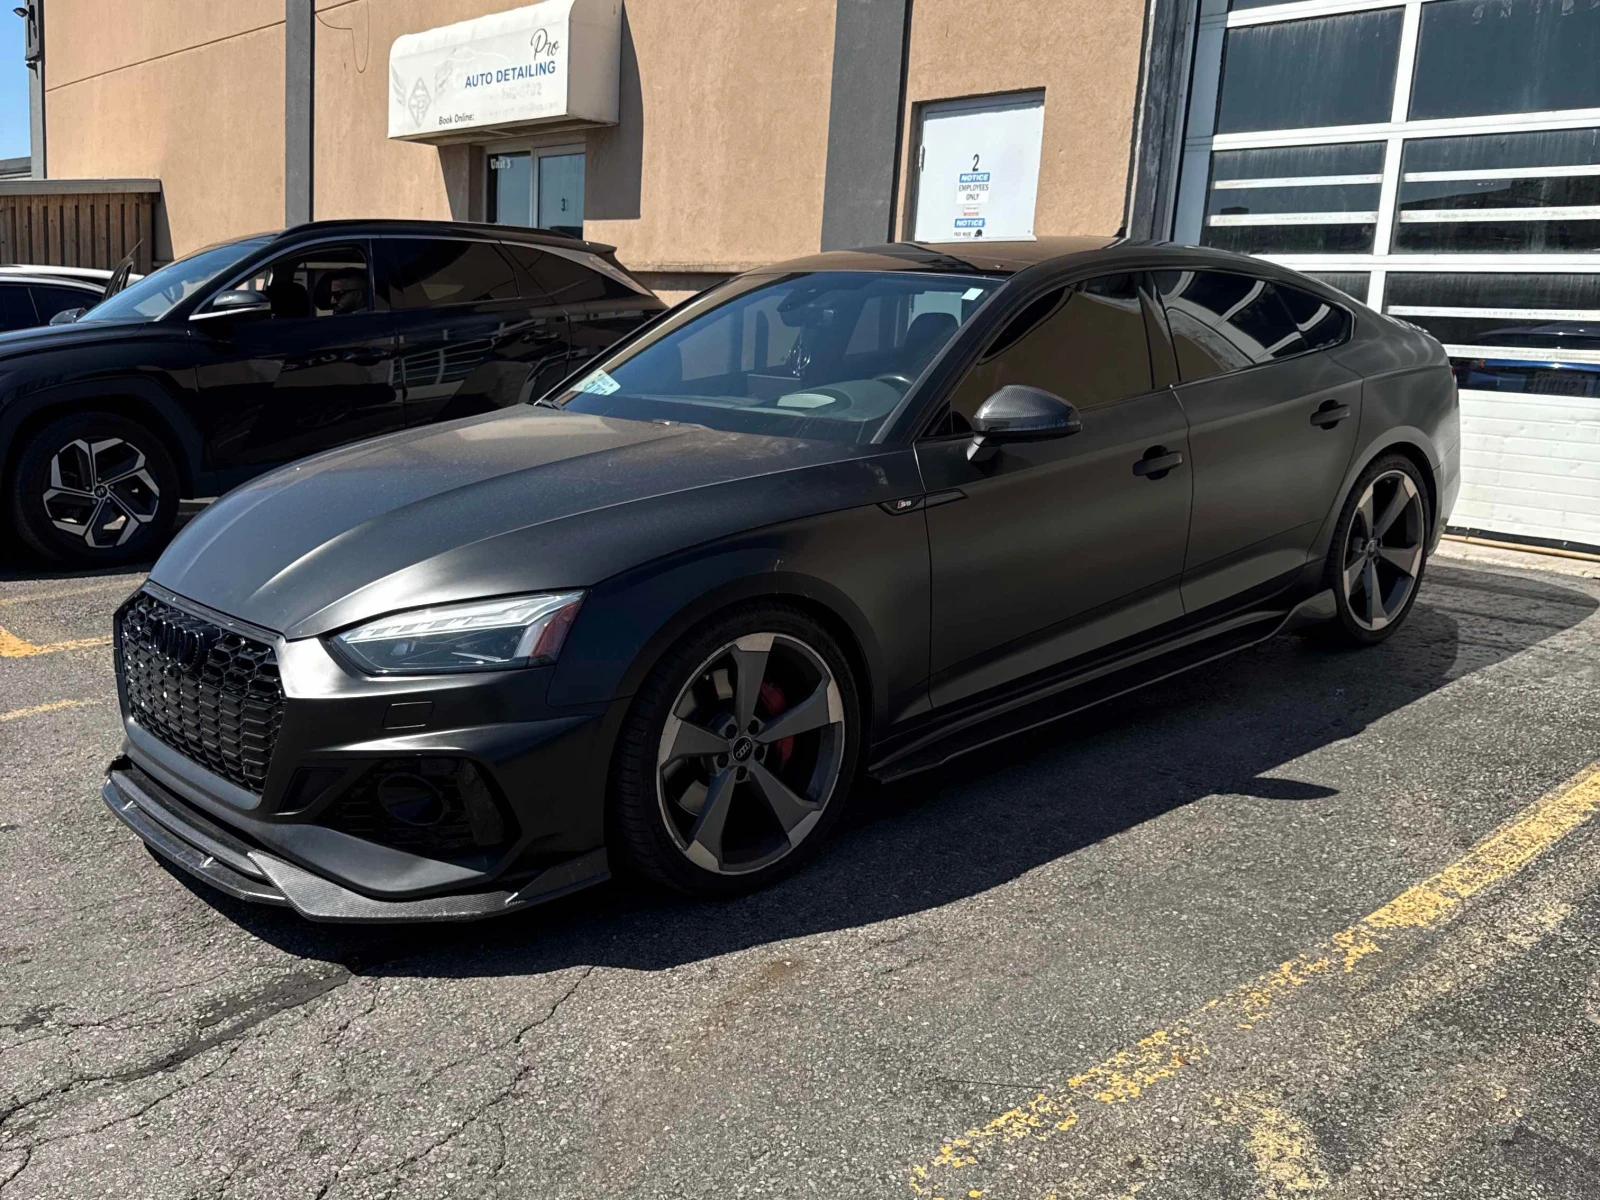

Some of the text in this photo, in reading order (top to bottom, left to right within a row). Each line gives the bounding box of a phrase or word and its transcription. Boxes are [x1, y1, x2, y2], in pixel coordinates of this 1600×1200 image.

[530, 28, 559, 60] Pro
[465, 60, 556, 88] AUTO DETAILING
[439, 112, 475, 125] Book Online:
[490, 158, 506, 169] Unit
[972, 153, 980, 172] 2
[960, 173, 989, 182] NOTICE
[965, 193, 980, 201] ONLY
[561, 198, 567, 212] 3
[956, 219, 984, 227] NOTICE
